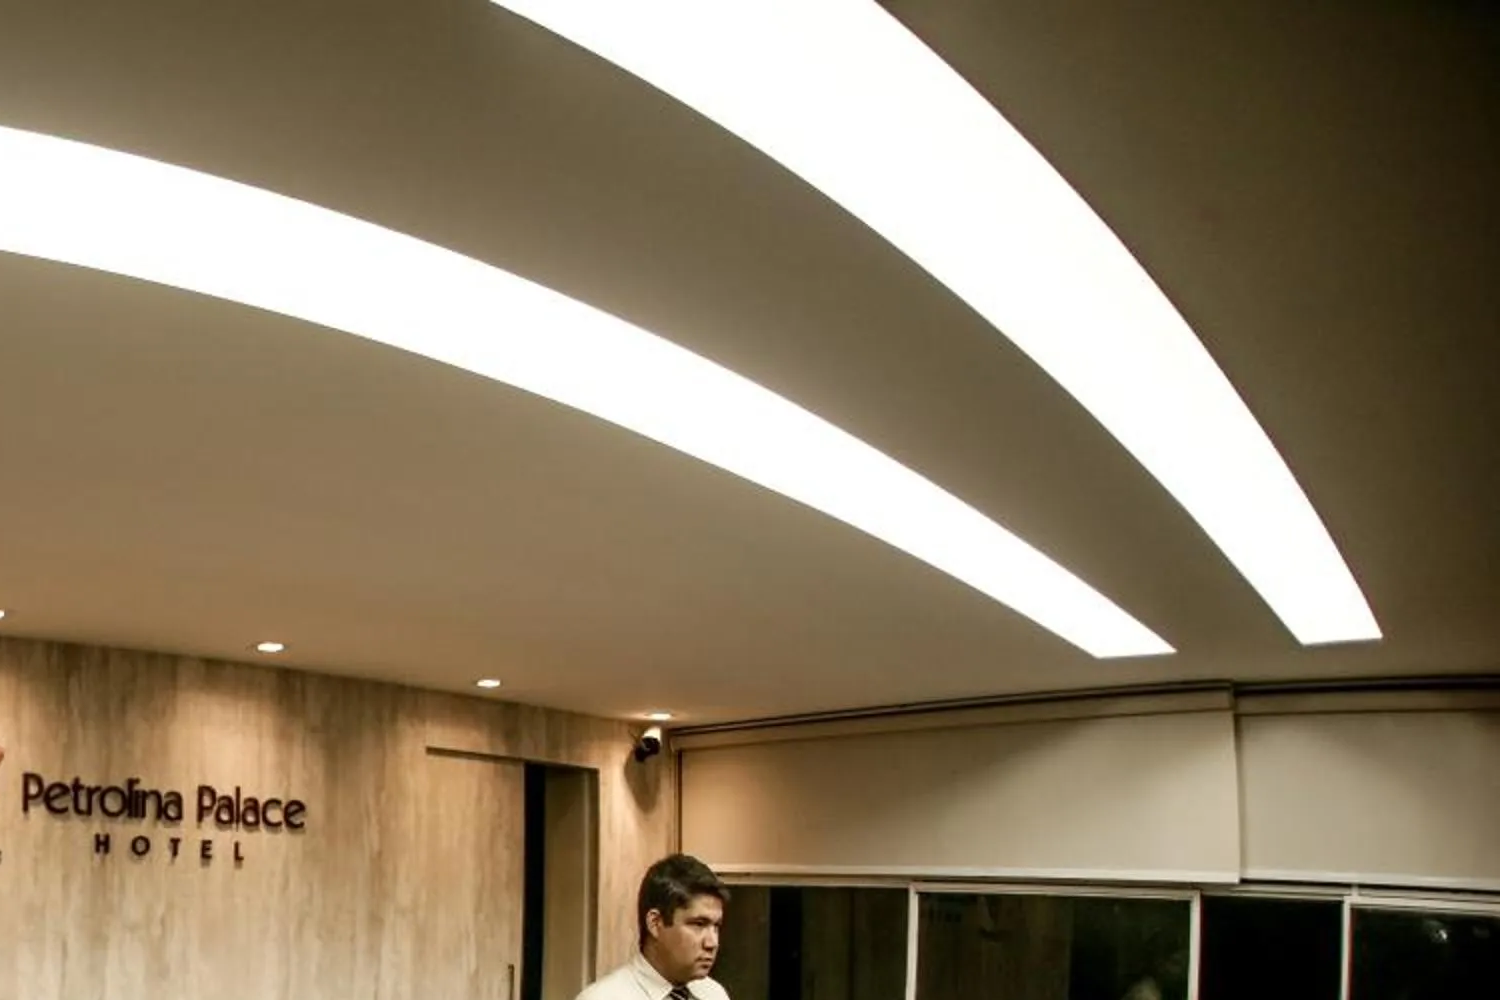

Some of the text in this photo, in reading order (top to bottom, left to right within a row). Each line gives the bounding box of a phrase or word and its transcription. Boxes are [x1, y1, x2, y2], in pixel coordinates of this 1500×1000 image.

[22, 773, 307, 829] Petrolina Palace
[95, 833, 245, 861] HOTEL
